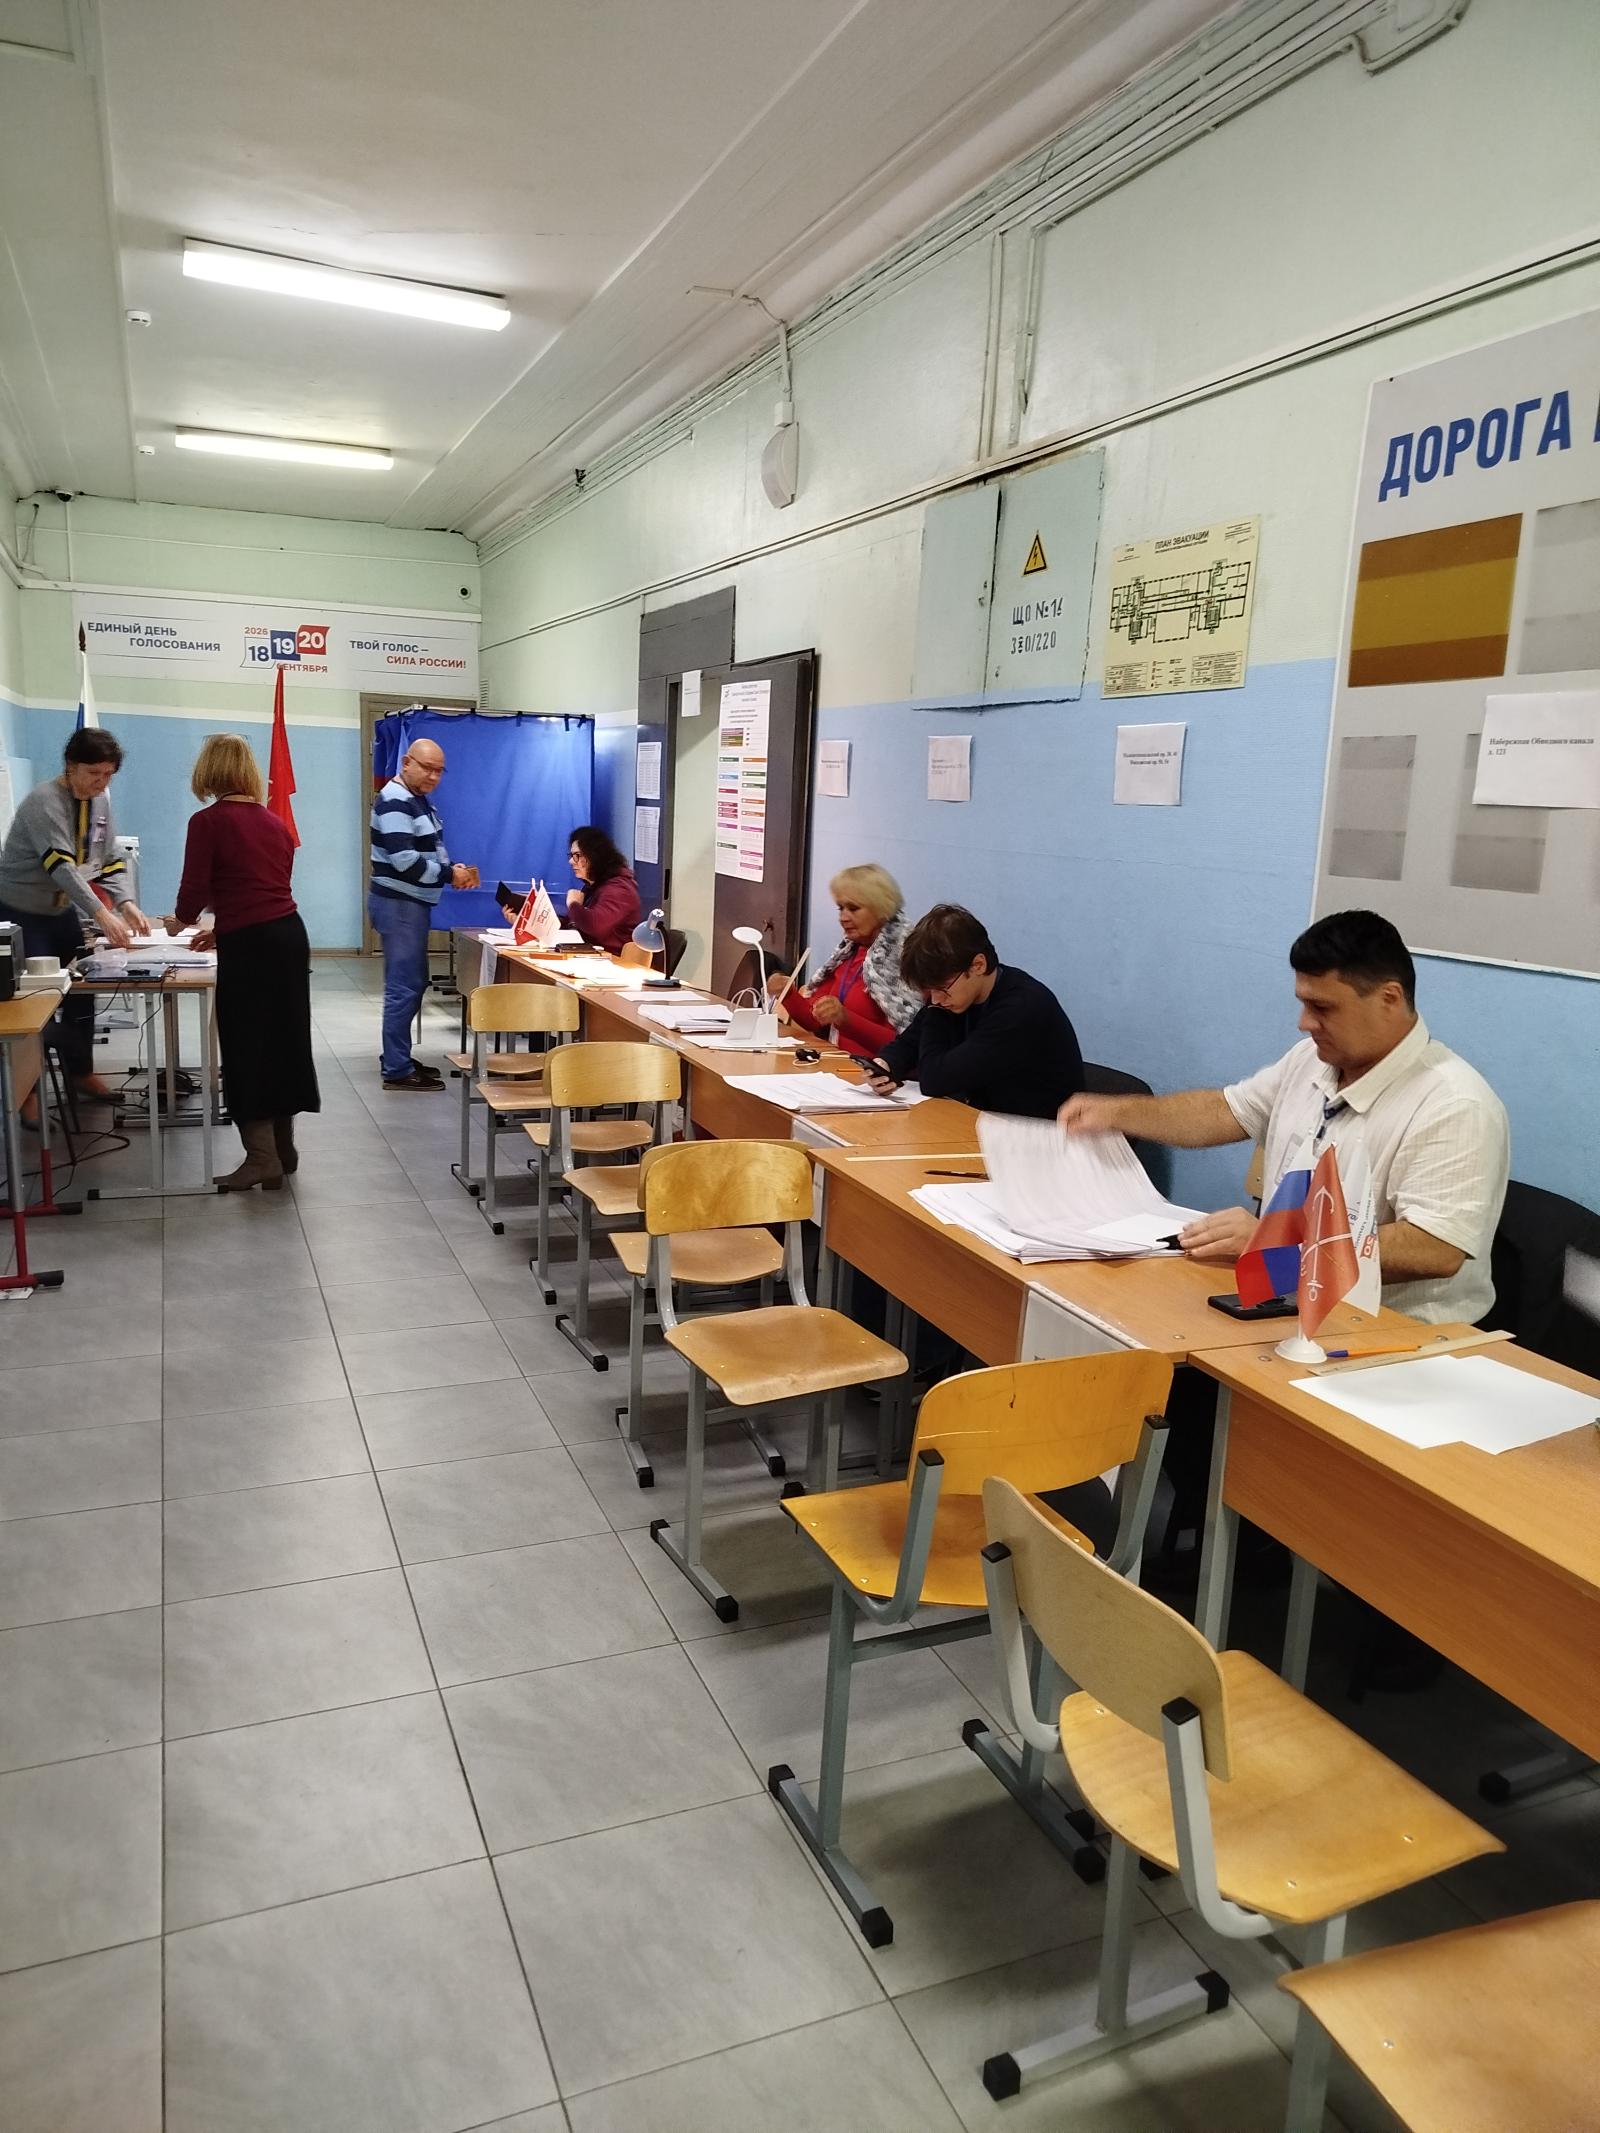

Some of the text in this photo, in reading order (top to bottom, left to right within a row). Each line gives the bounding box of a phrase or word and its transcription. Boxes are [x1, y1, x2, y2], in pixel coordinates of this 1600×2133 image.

[1378, 390, 1571, 503] ДОРОГА
[1155, 540, 1172, 550] ПЛАН
[1172, 530, 1210, 546] ЭВАКУАЦИИ
[87, 622, 177, 636] ЕДИНЫЙ ДЕНЬ
[244, 626, 268, 635] 2026
[129, 637, 221, 651] ГОЛОСОВАНИЯ
[272, 637, 295, 655] 19
[298, 631, 325, 649] 20
[349, 640, 380, 651] ТВОЙ
[382, 642, 419, 653] ГОЛОС
[1011, 630, 1056, 655] 380/220
[248, 645, 270, 662] 18
[386, 655, 467, 669] СИЛА РОССИИ!
